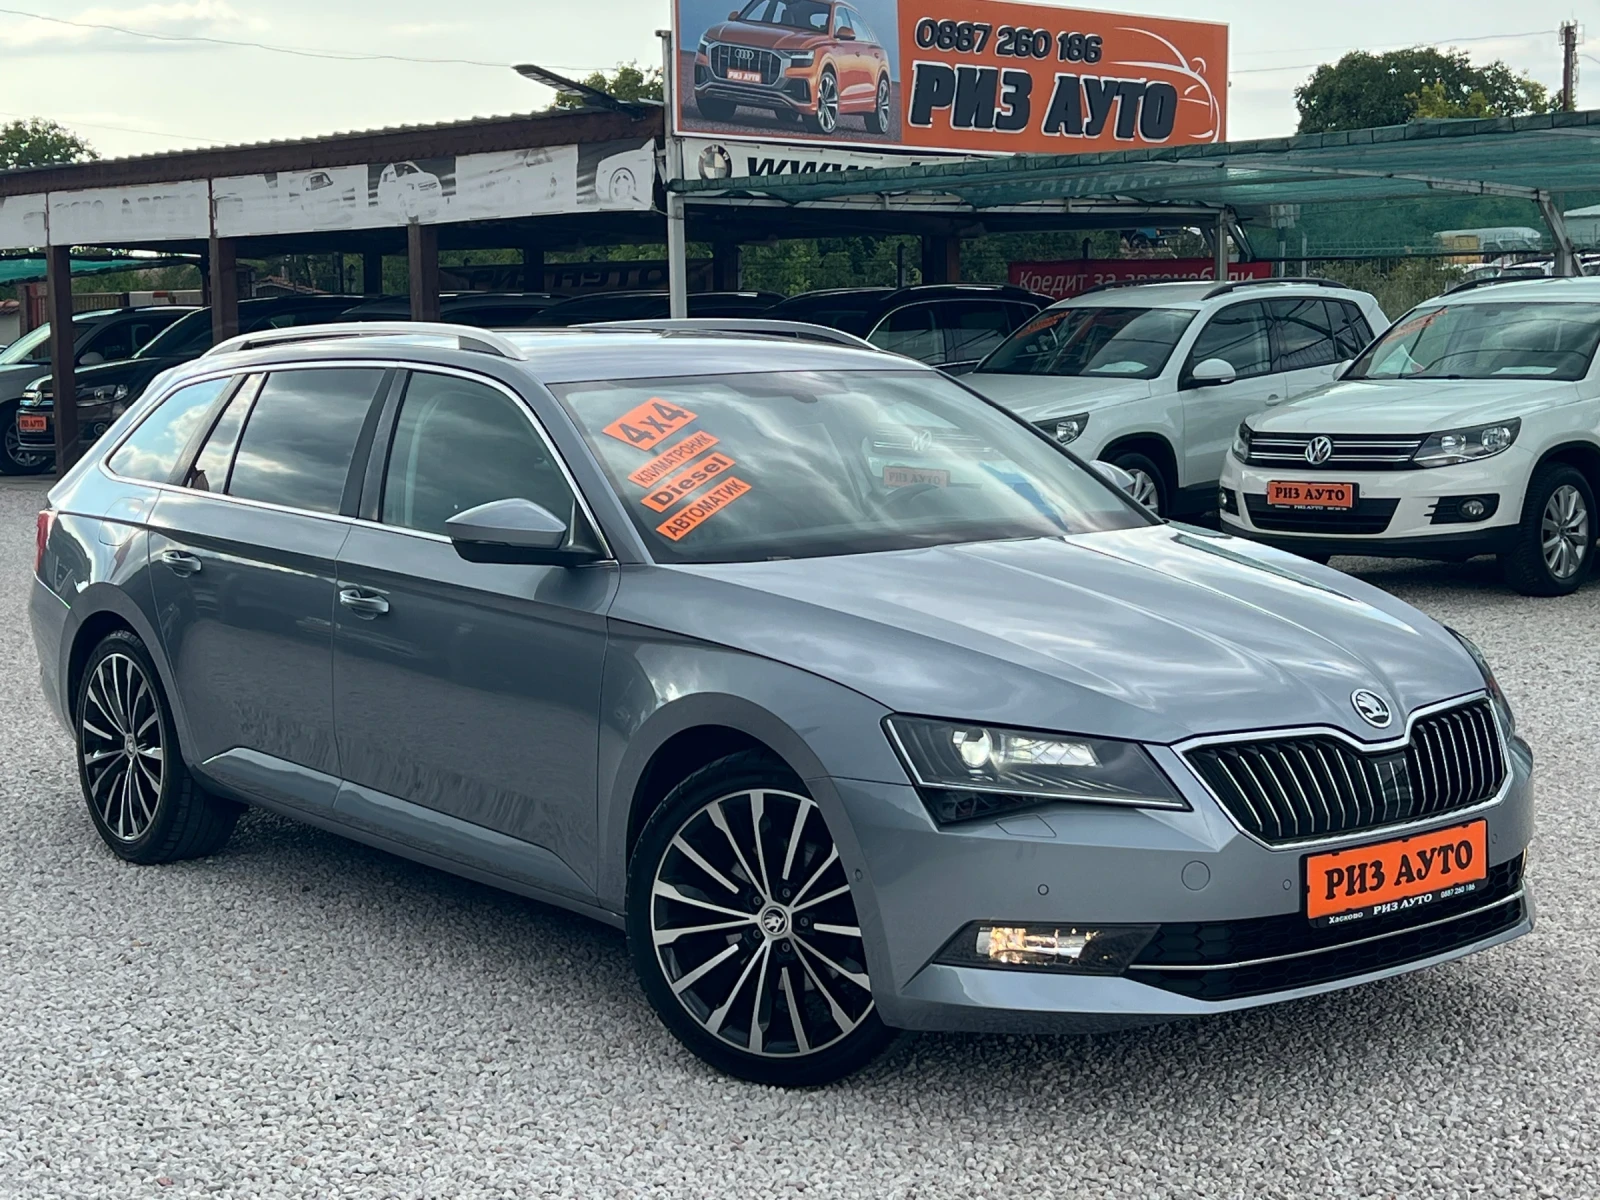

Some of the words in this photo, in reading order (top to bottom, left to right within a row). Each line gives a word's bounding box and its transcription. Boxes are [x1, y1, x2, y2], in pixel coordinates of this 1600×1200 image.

[916, 17, 992, 53] 0887
[995, 25, 1052, 59] 260
[1058, 31, 1103, 64] 186
[908, 60, 1032, 132] РИЗ
[1041, 73, 1178, 142] АУТО
[1019, 271, 1088, 296] Кредит
[650, 456, 728, 506] Diesel
[1275, 487, 1300, 499] РИЗ
[1304, 488, 1345, 501] АУТО
[665, 479, 747, 537] АВТОМАТИК
[1324, 859, 1386, 900] РИЗ
[1394, 840, 1473, 886] АУТО
[1328, 911, 1363, 924] Хасково
[1373, 901, 1398, 916] РИЗ
[1400, 893, 1433, 910] АУТО
